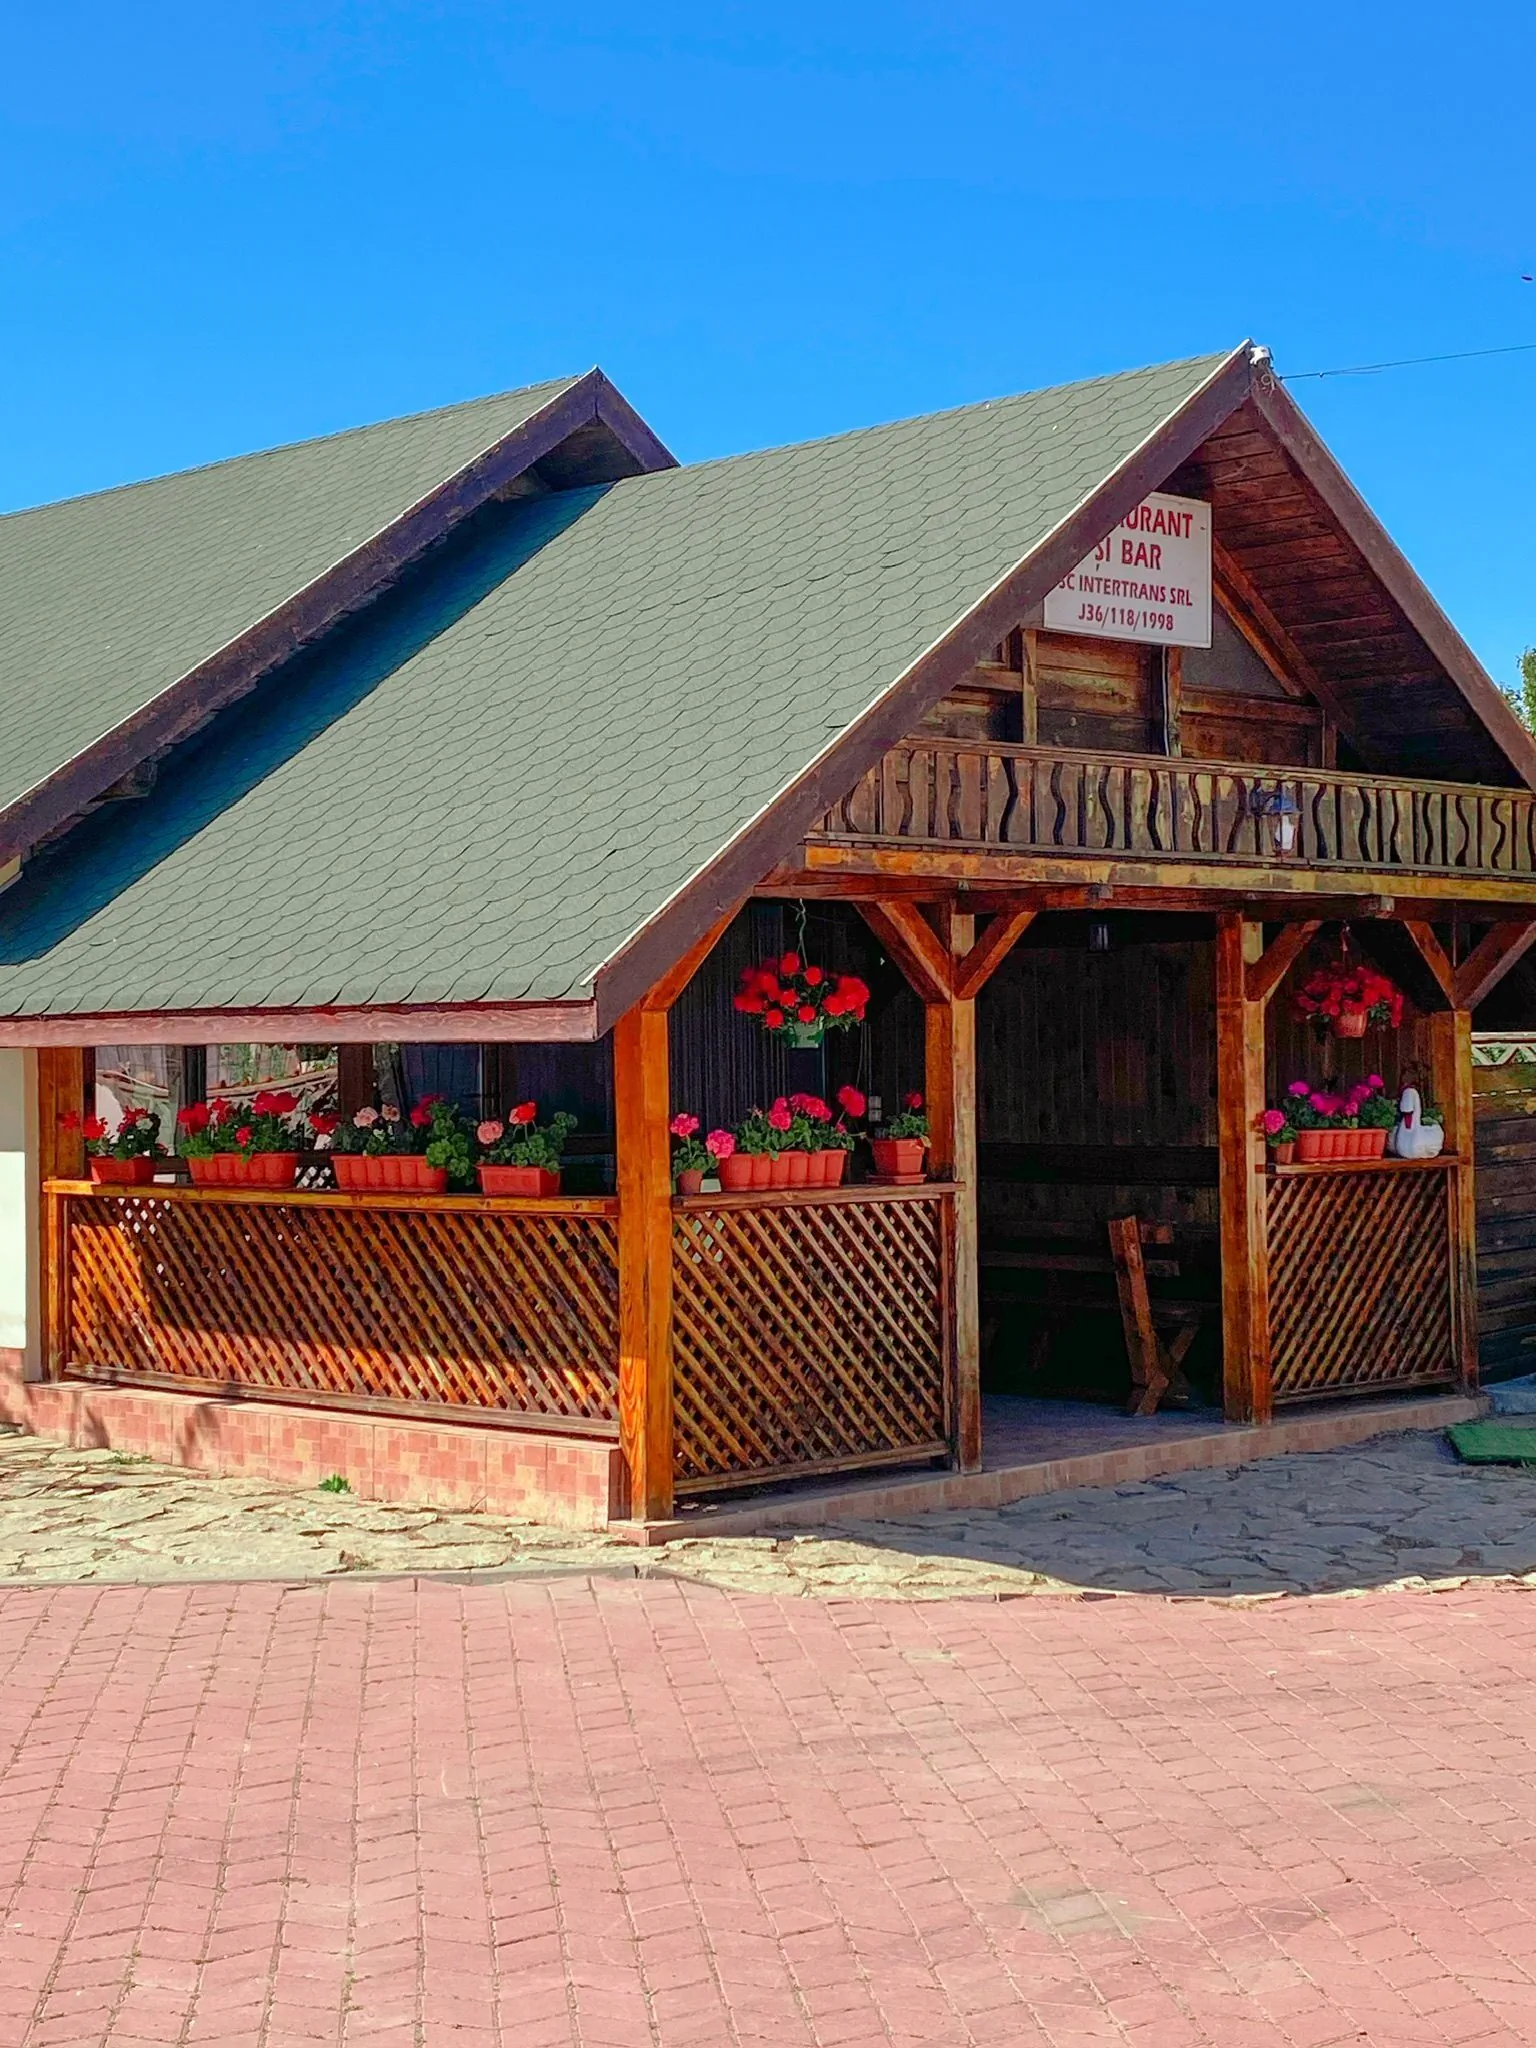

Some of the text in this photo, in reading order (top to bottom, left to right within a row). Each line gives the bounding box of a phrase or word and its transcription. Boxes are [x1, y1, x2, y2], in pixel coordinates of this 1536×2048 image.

[1120, 507, 1193, 538] URANT
[1121, 540, 1162, 570] BAR
[1079, 575, 1166, 602] INTERTRANS
[1170, 588, 1193, 606] SRL
[1078, 604, 1174, 631] J36/118/1998
